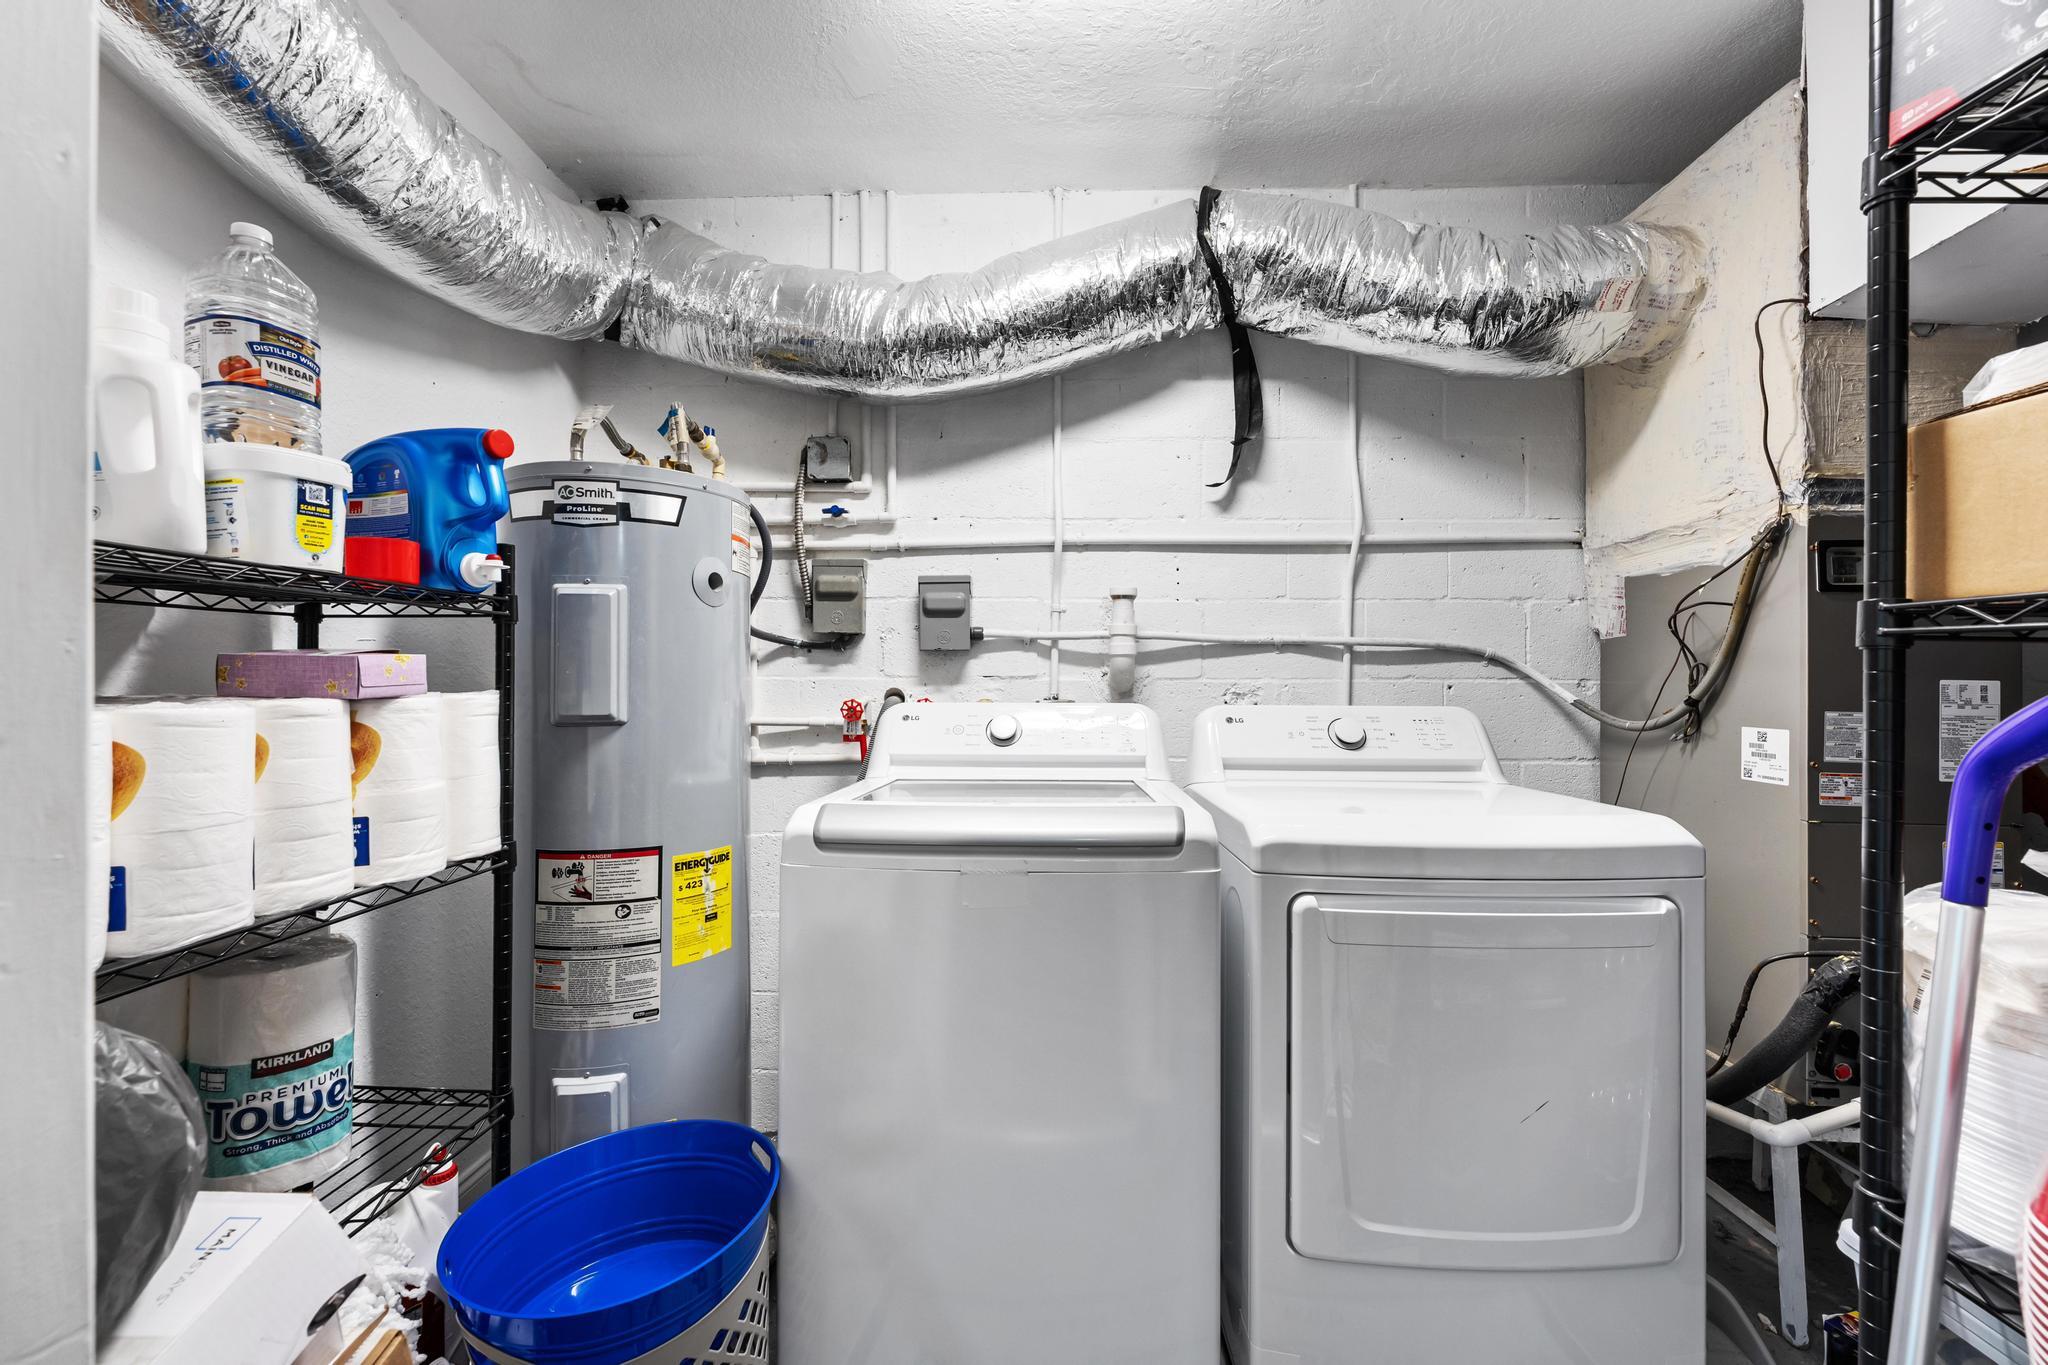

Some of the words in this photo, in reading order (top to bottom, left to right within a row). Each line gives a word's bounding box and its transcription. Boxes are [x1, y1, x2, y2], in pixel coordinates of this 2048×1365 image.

[252, 344, 298, 359] DISTILLED
[300, 355, 320, 373] WHITE
[265, 359, 314, 384] VINEGAR
[575, 487, 613, 499] Smith
[685, 879, 703, 890] 423
[256, 1042, 332, 1070] KIRKLAND
[246, 1066, 344, 1105] PREMIUM
[226, 1144, 263, 1156] Strong,
[266, 1135, 293, 1147] Thick
[295, 1128, 313, 1139] and
